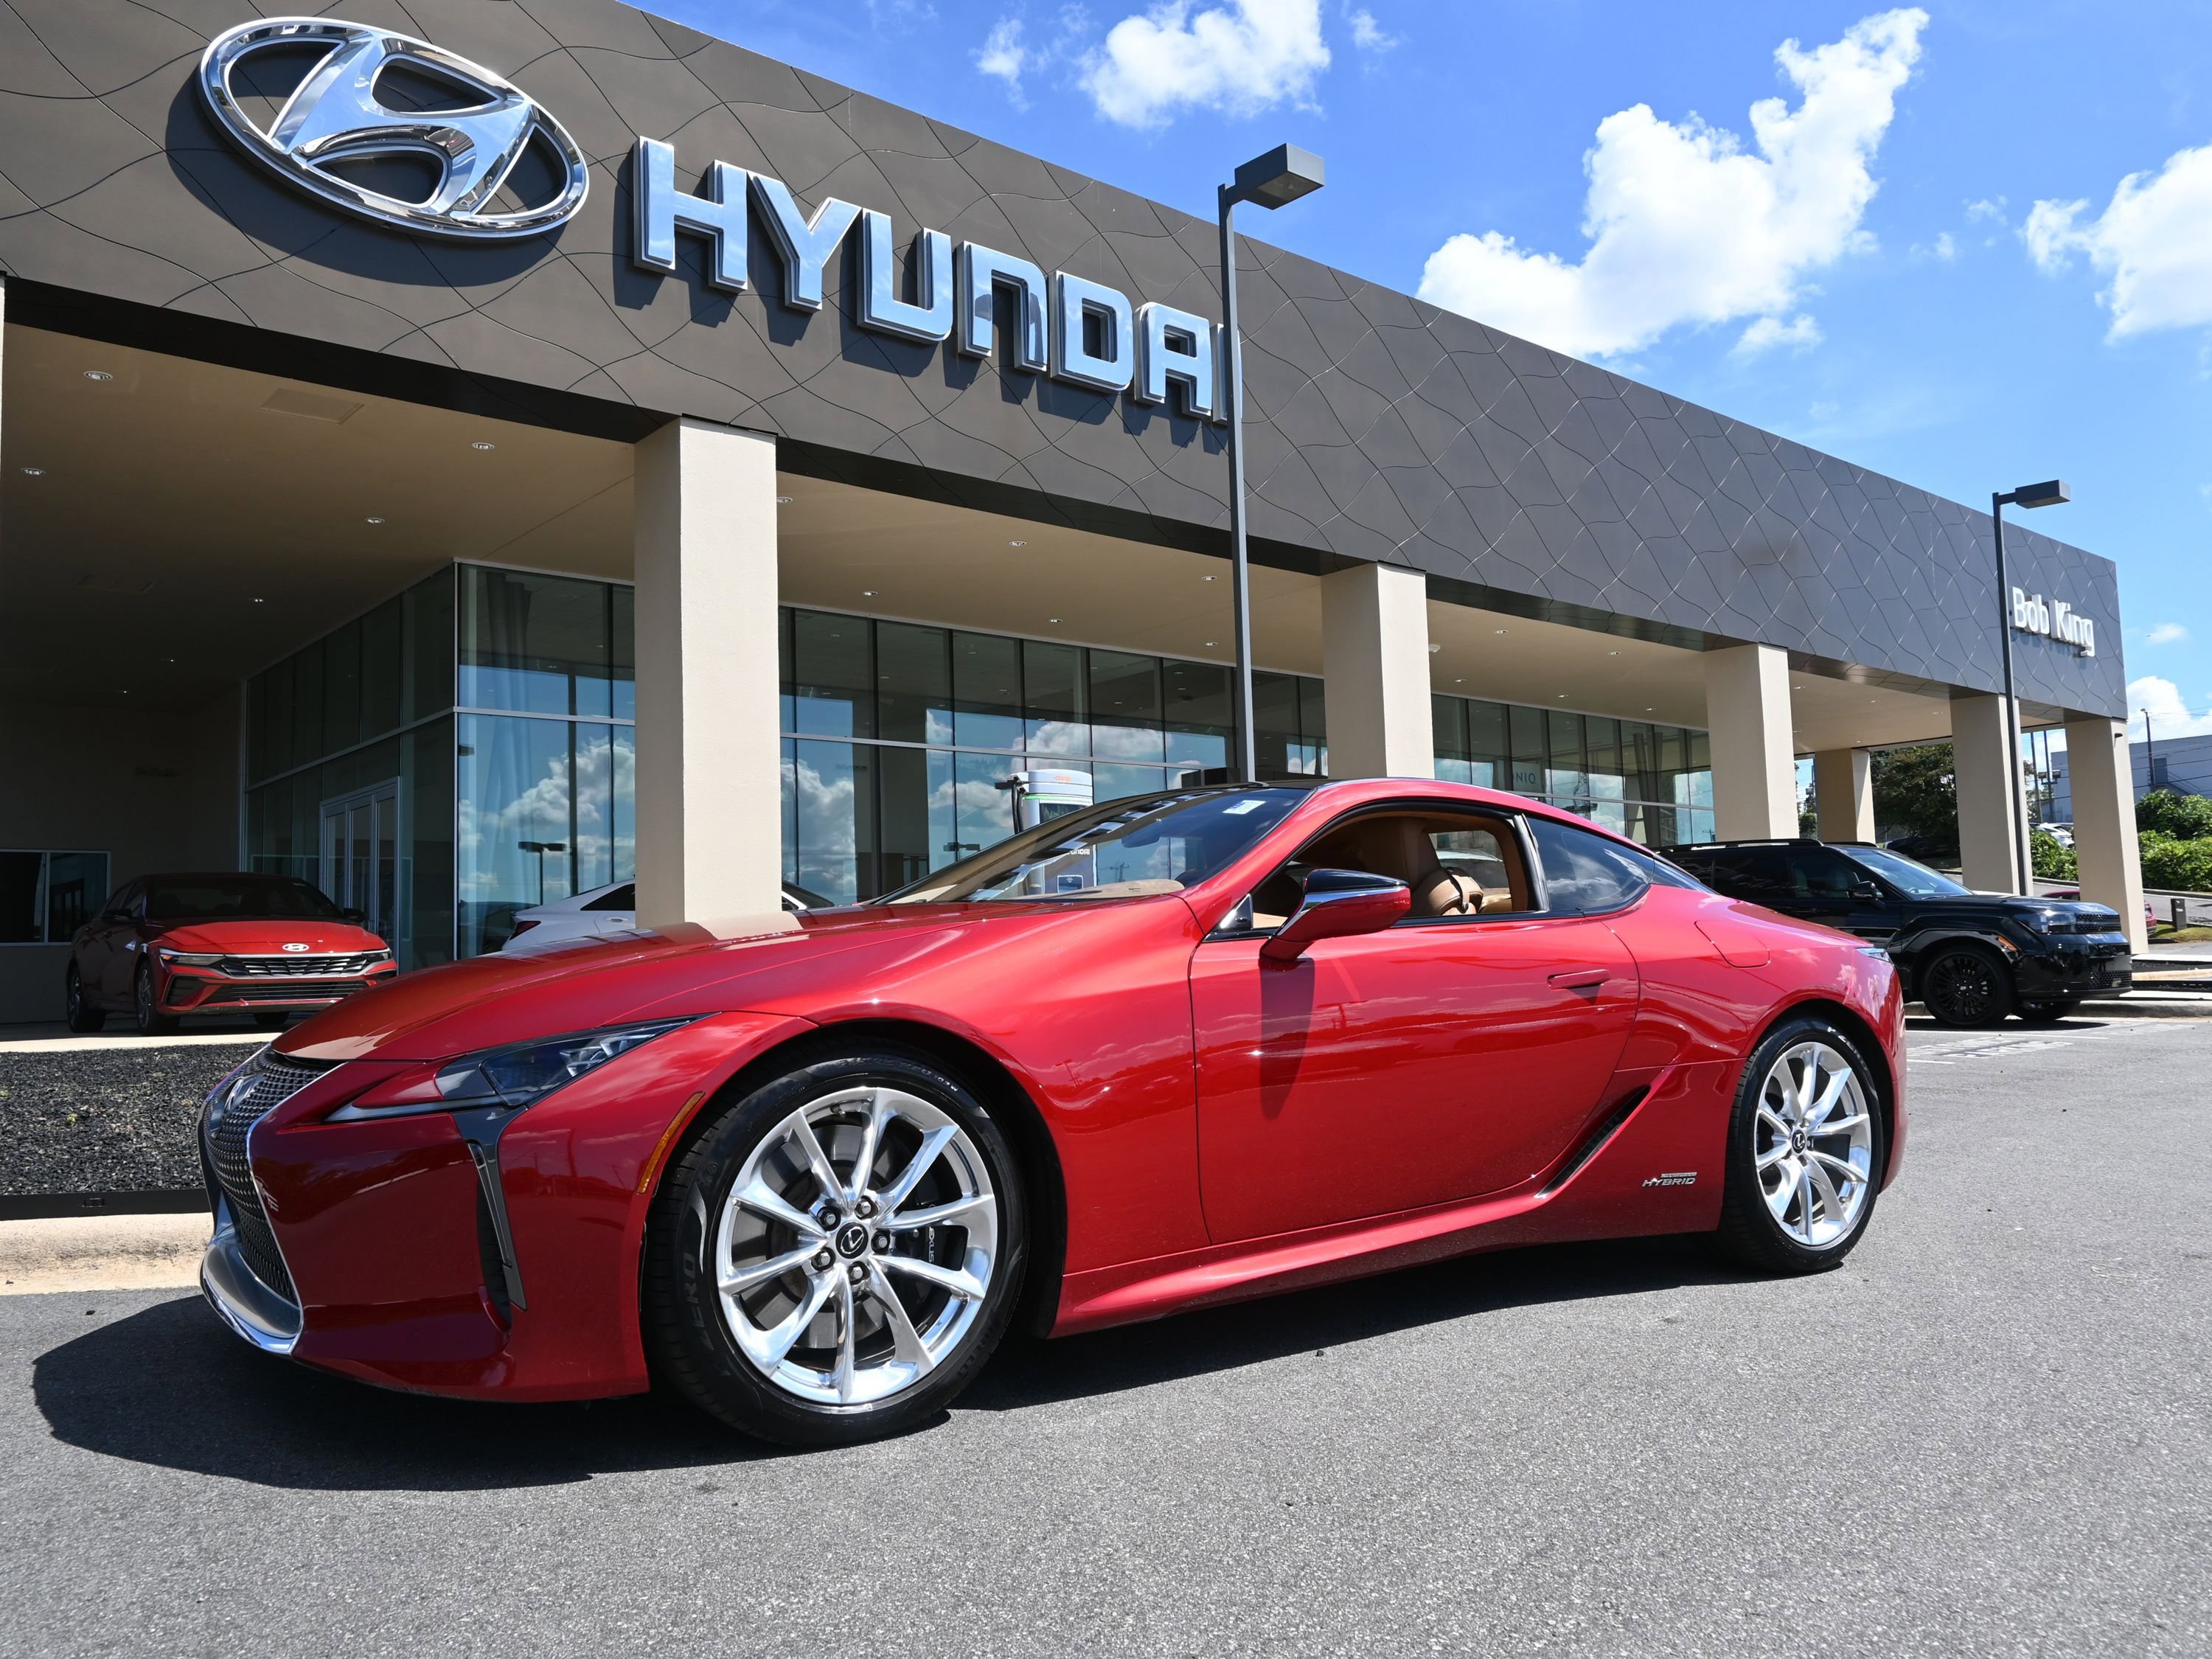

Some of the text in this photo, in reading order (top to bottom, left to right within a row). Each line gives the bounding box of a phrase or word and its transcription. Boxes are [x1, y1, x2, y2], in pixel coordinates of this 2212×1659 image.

[2009, 586, 2096, 658] Bob King
[1641, 1177, 1696, 1187] HYBRID
